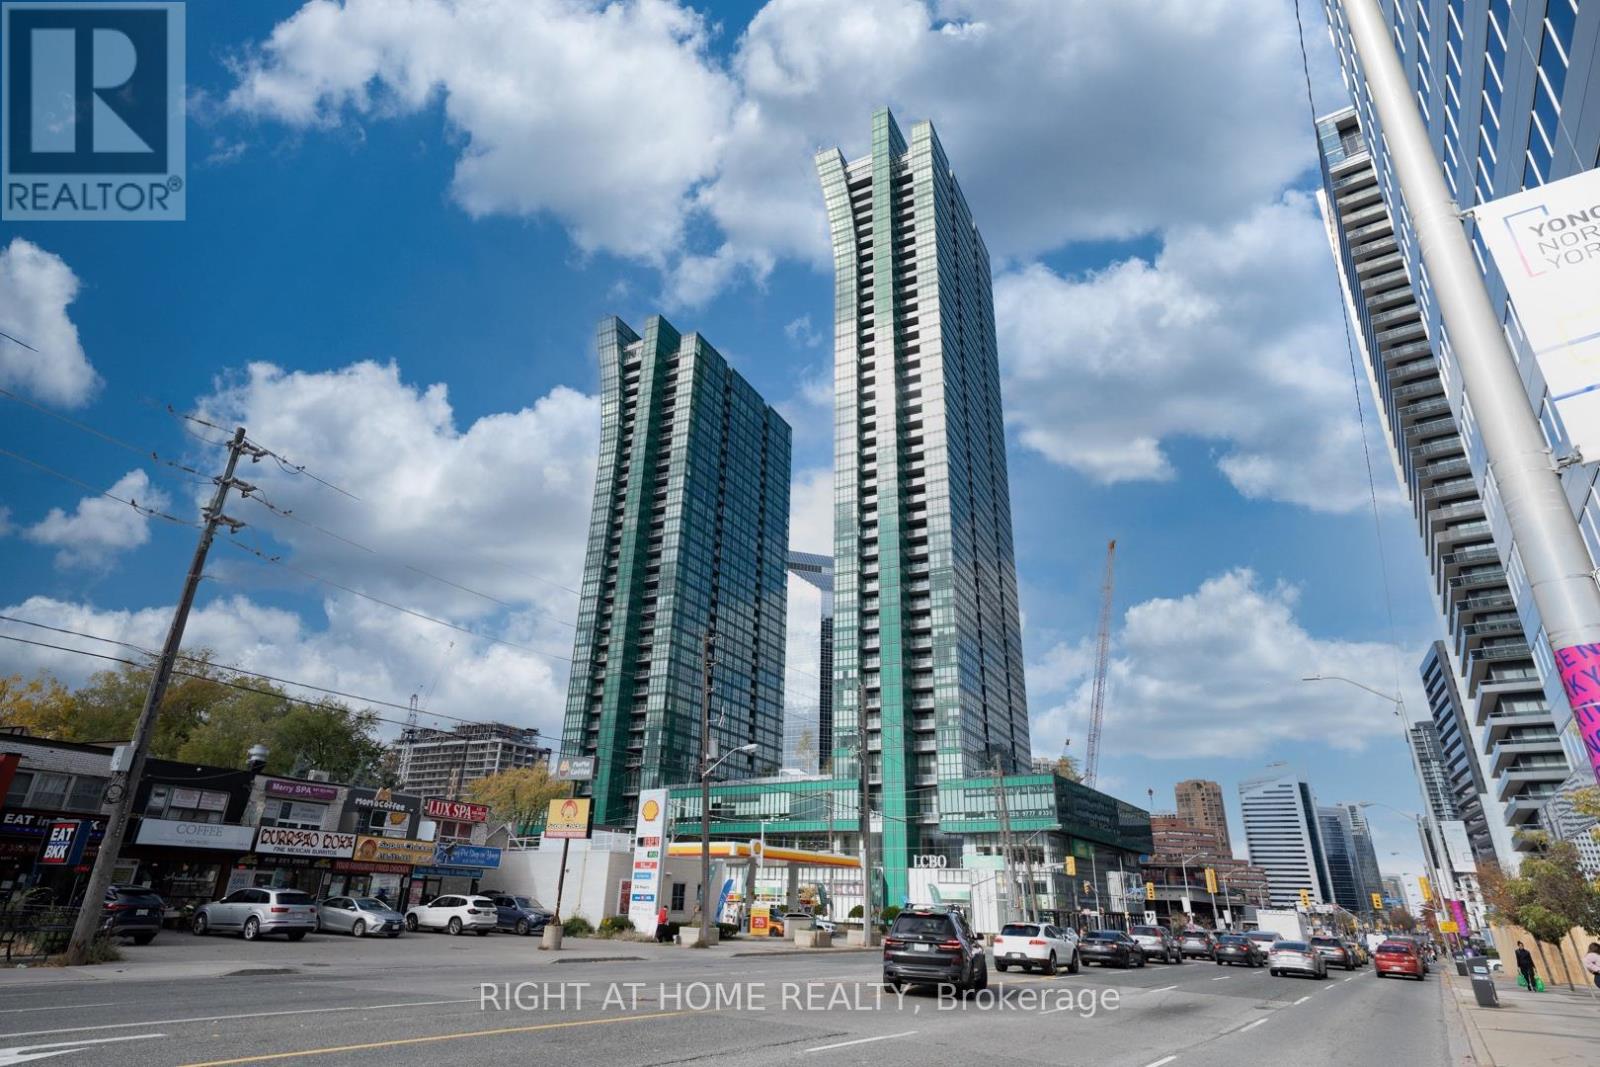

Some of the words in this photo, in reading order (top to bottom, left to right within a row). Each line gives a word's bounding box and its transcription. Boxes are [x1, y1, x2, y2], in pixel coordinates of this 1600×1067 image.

[1537, 223, 1600, 255] NOR
[272, 783, 294, 793] Merry
[295, 785, 312, 794] SPA
[429, 800, 452, 817] LUX
[452, 804, 472, 819] SPA
[3, 813, 35, 825] EAT
[50, 827, 75, 842] EAT
[176, 823, 224, 838] COFFEE
[44, 844, 69, 859] BKK
[287, 847, 311, 855] MEXICAN
[913, 855, 947, 870] LCBO
